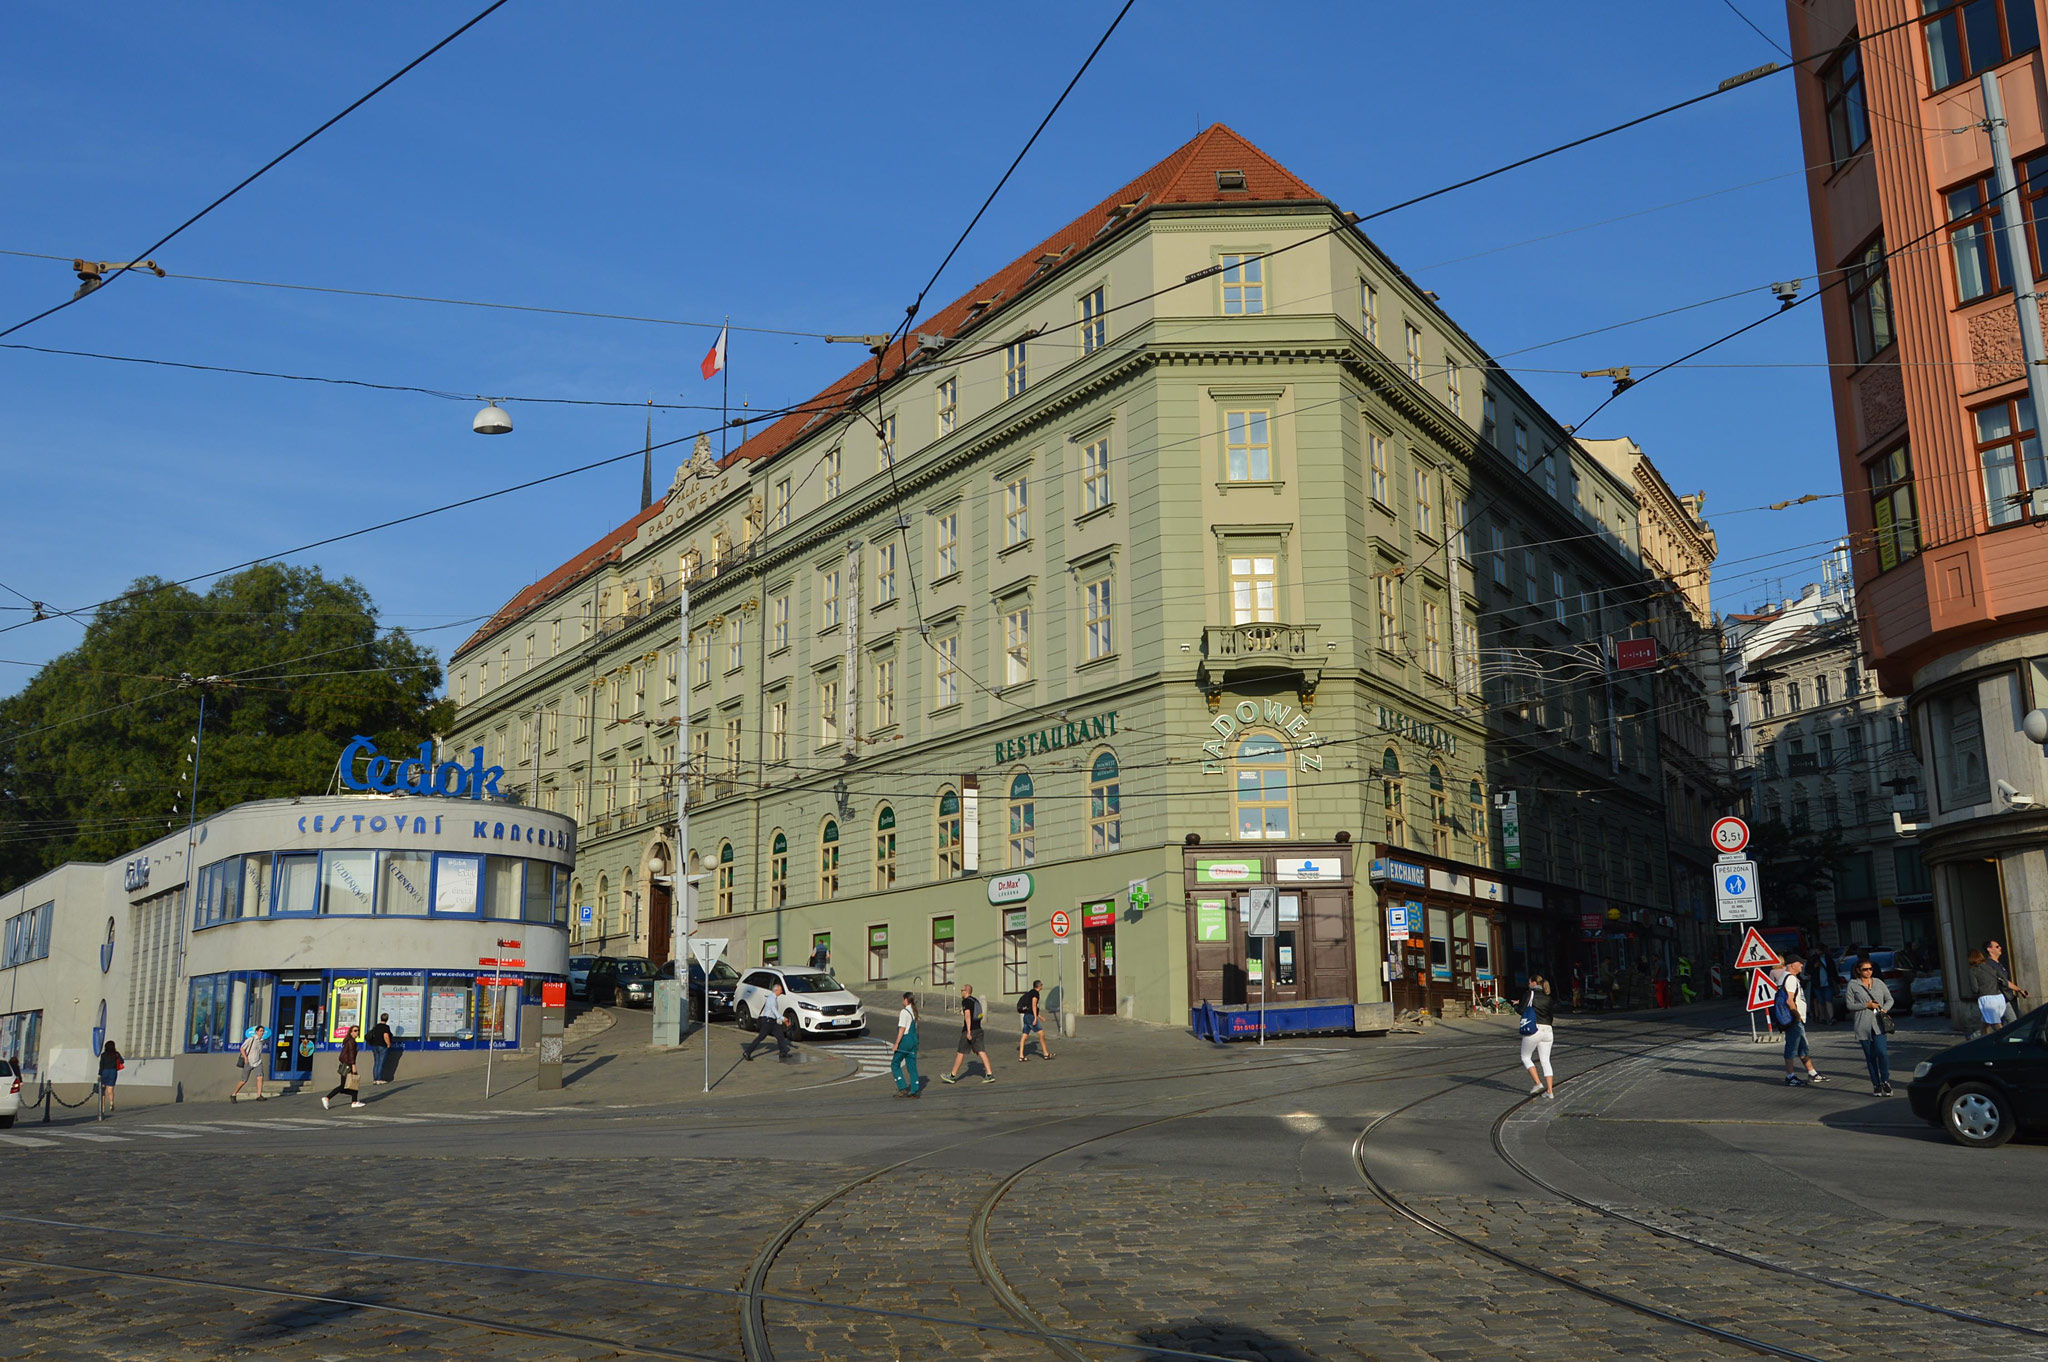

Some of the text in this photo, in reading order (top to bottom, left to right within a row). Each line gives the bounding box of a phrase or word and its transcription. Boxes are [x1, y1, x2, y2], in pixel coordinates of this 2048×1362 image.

[648, 477, 729, 537] PADOWETZ
[995, 711, 1118, 765] RESTAURANT
[1202, 698, 1322, 775] PADOWETZ
[1376, 705, 1457, 757] RESTAURANT
[340, 734, 508, 800] Čedok
[297, 814, 444, 834] CESTOVNÍ
[998, 880, 1019, 891] Dr.Max
[1390, 862, 1425, 884] EXCHANGE
[583, 908, 590, 917] P
